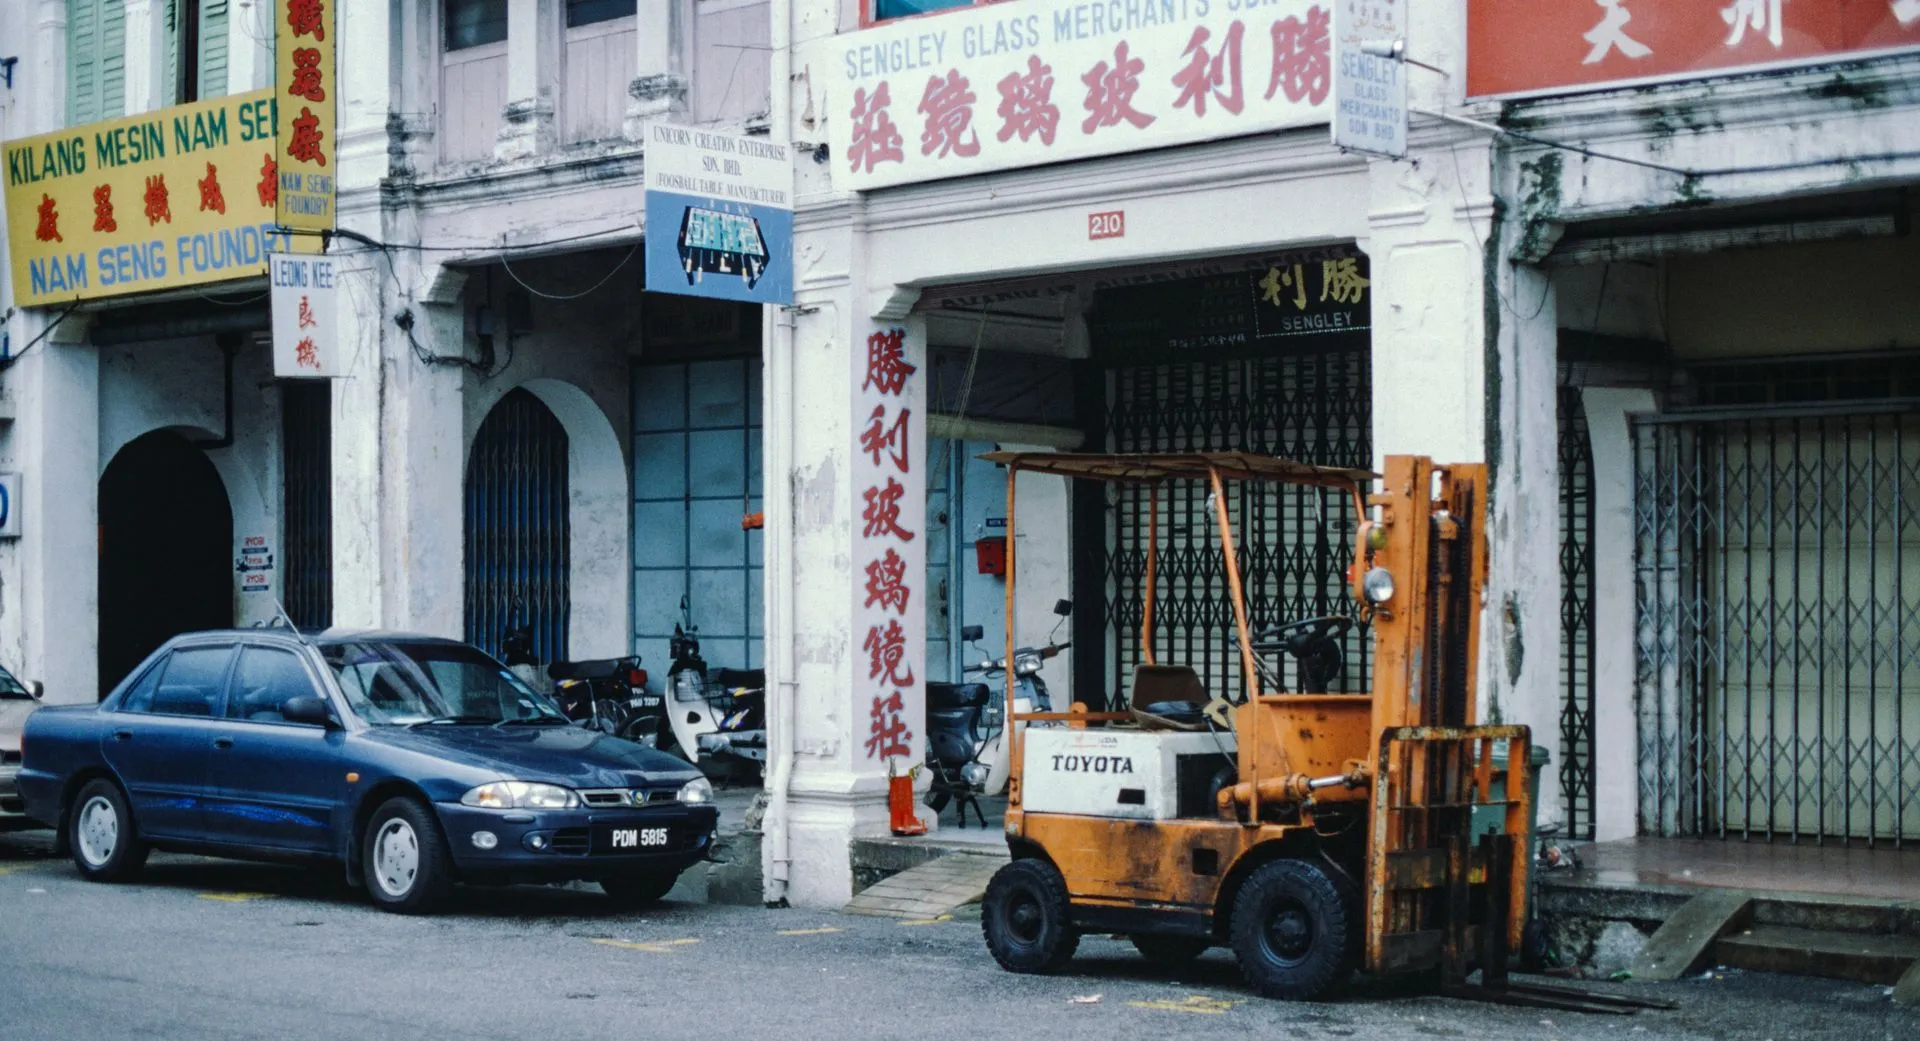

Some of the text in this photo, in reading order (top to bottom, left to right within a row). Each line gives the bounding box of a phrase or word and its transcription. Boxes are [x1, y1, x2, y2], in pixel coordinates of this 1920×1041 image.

[845, 31, 948, 81] SENGLEY
[962, 15, 1040, 59] GLASS
[1341, 51, 1399, 87] SENGLEY
[1354, 82, 1388, 102] GLASS
[1340, 98, 1401, 124] MERCHANTS
[9, 136, 86, 187] KILANG
[95, 121, 166, 169] MESIN
[173, 107, 228, 154] NAM
[653, 125, 787, 161] UNICORN CREATION ENTERPRISE
[281, 171, 332, 195] NAM SENG
[700, 178, 723, 195] TABLE
[285, 196, 329, 217] FOUNDRY
[1091, 214, 1121, 234] 210
[30, 252, 88, 297] NAM
[97, 240, 167, 287] SENG
[274, 260, 333, 289] LEONG KEE
[1282, 311, 1353, 331] SENGLEY
[1052, 755, 1134, 774] TOYOTA
[612, 827, 668, 848] PDM 5815
